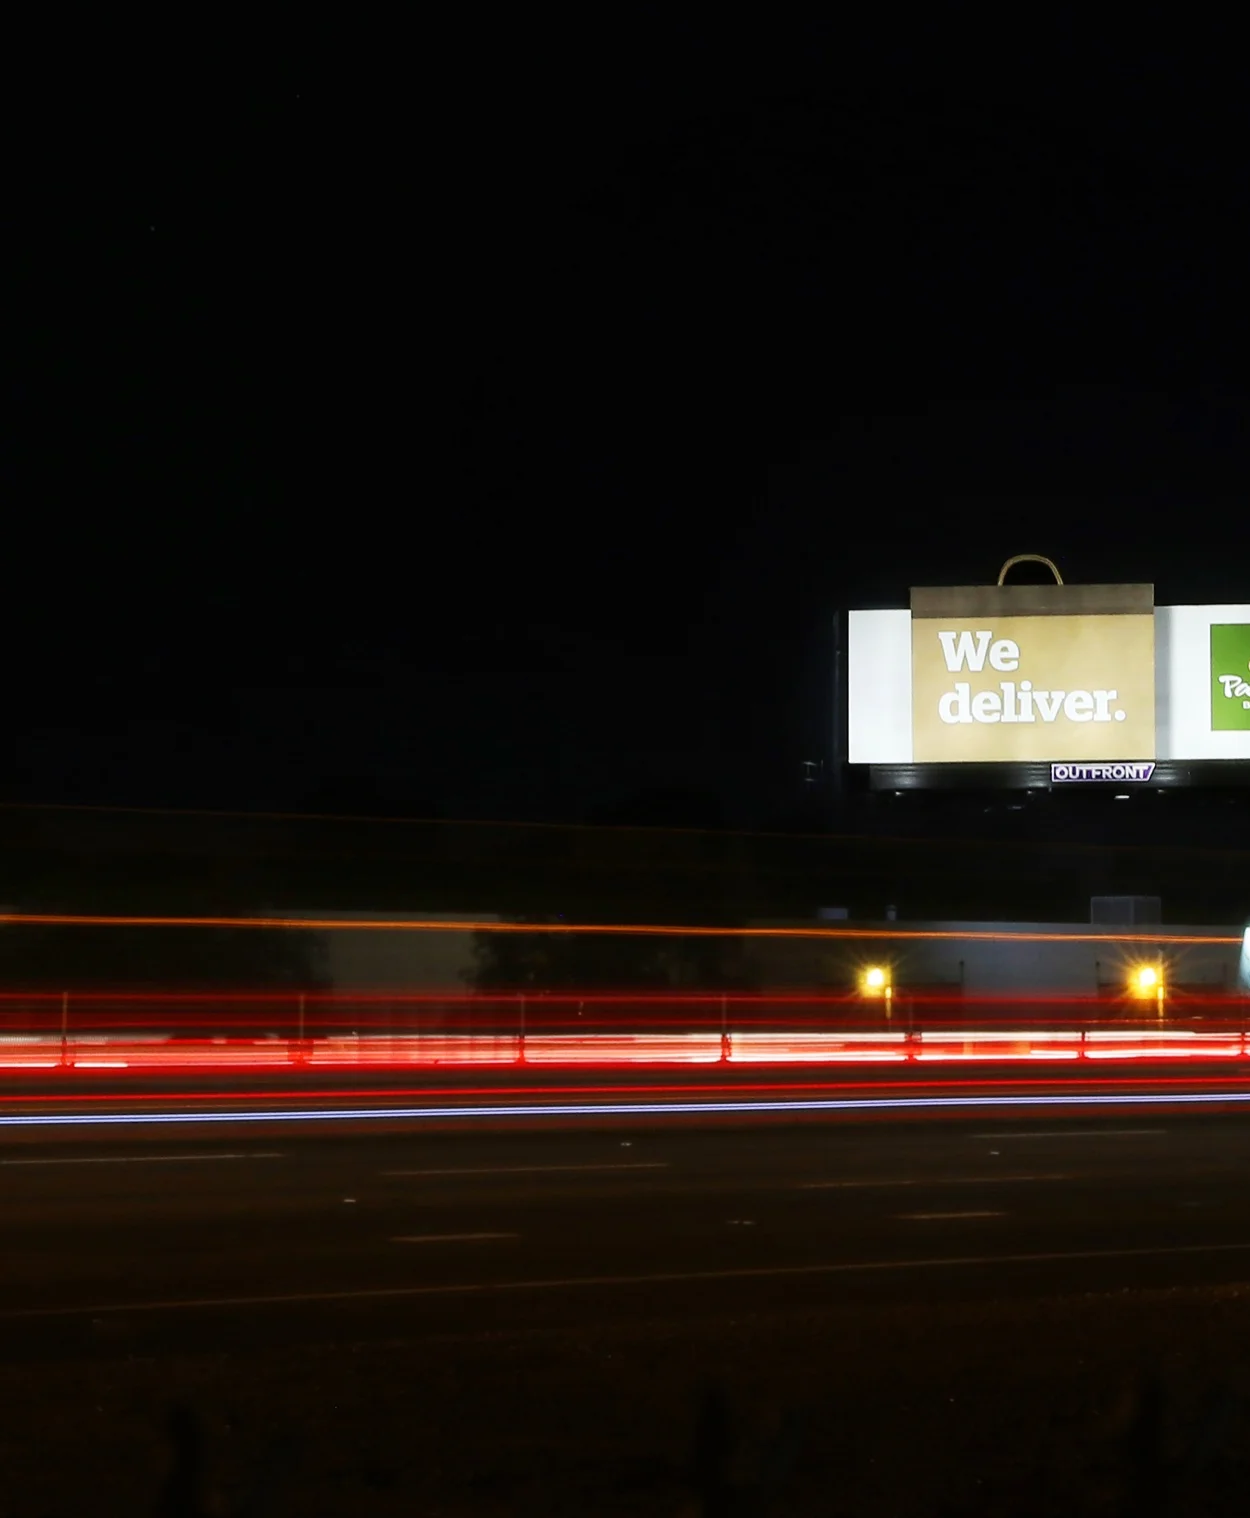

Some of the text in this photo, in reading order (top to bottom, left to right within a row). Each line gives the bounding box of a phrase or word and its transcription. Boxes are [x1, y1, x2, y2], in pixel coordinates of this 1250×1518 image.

[938, 631, 1020, 671] We
[938, 680, 1126, 723] deliver.
[1055, 765, 1148, 779] OUTFRONT
